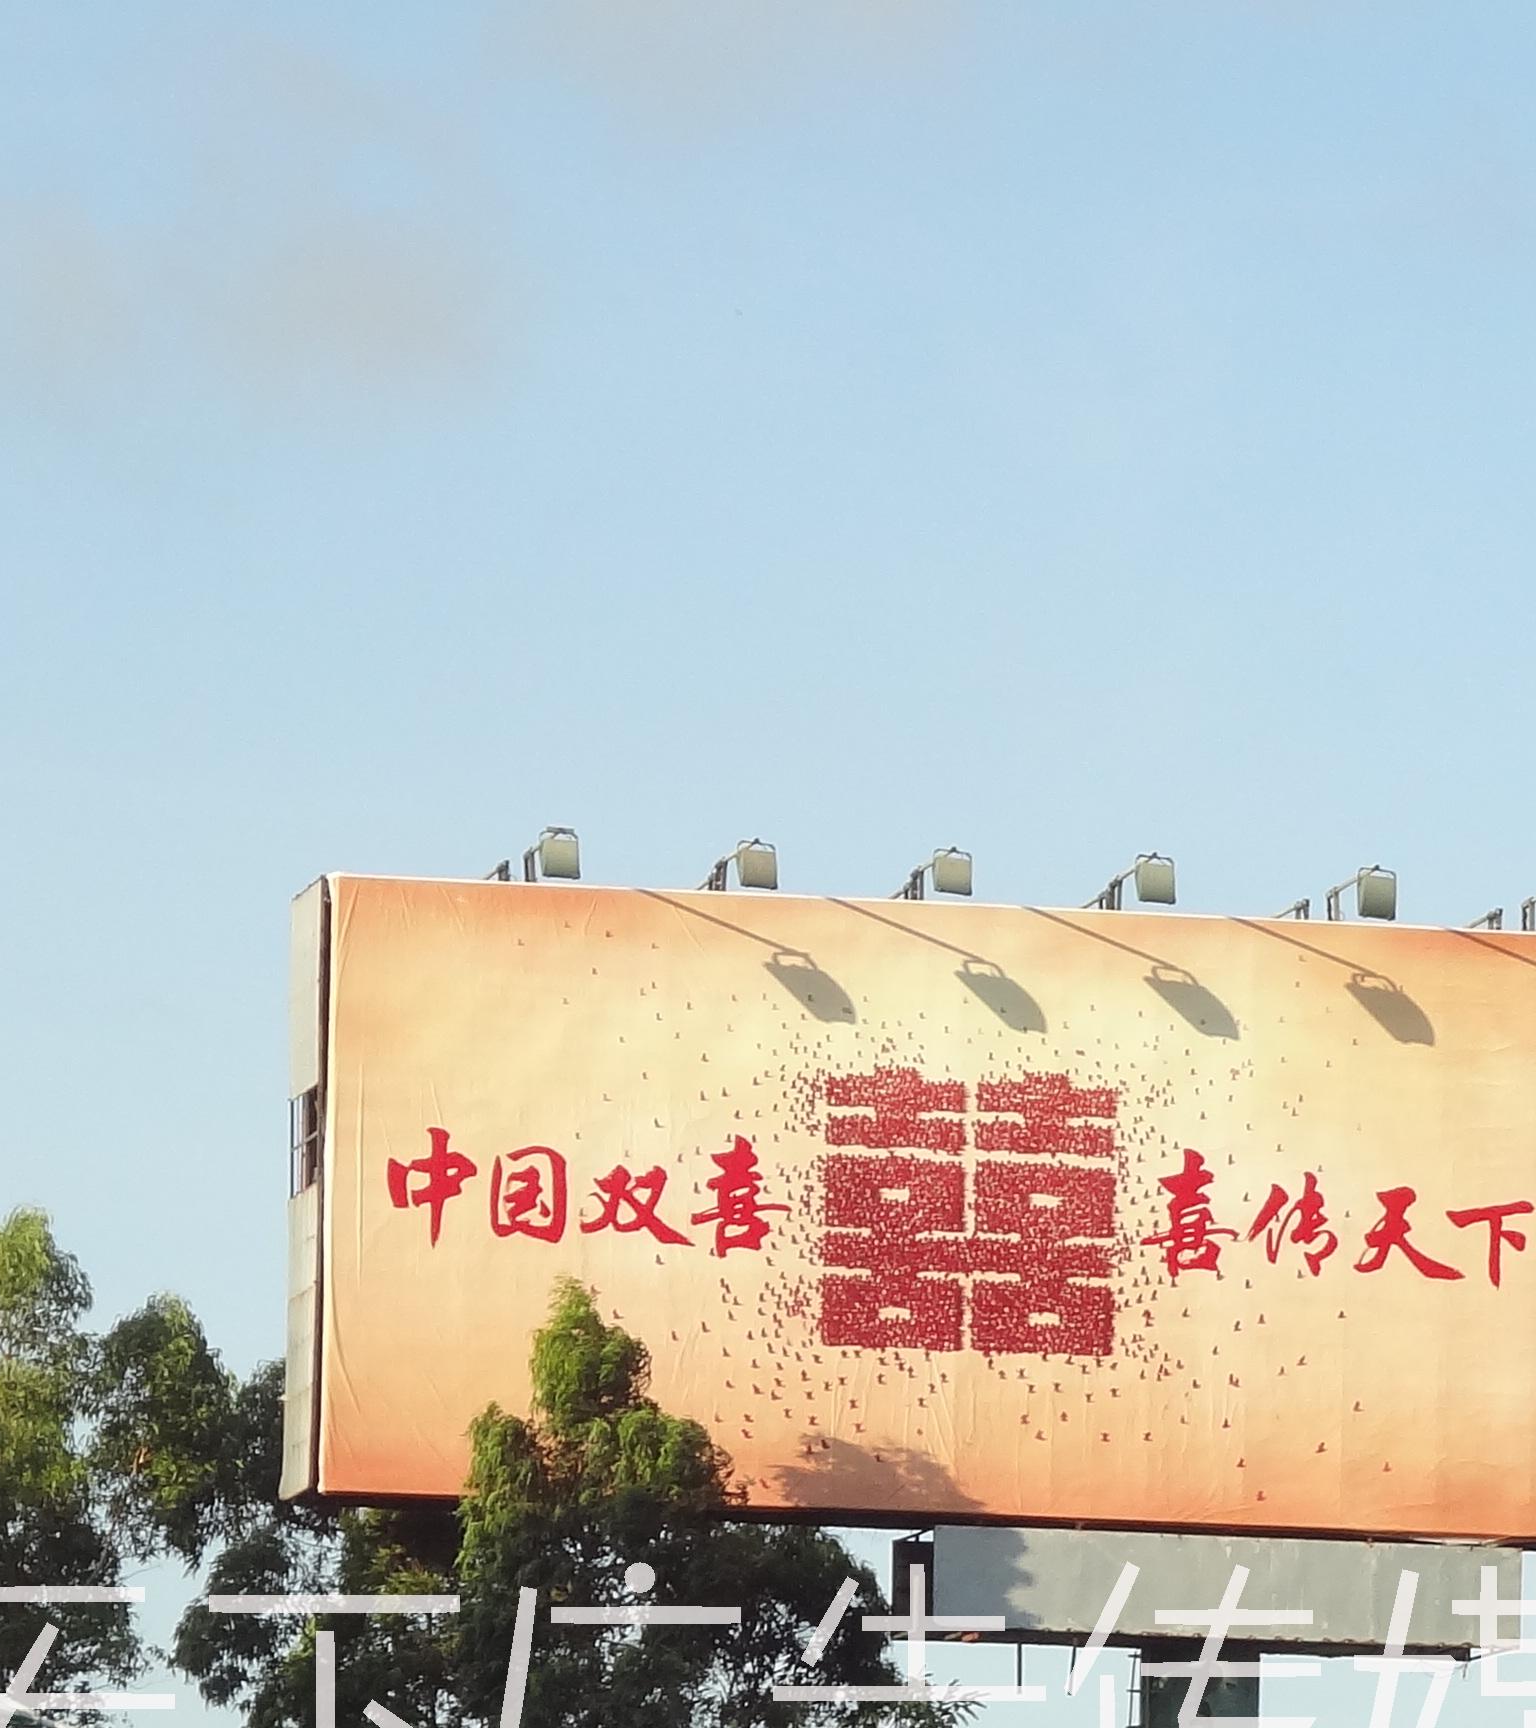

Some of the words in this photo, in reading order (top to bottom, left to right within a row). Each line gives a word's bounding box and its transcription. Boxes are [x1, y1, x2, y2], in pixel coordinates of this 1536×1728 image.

[387, 1127, 791, 1258] 中国双喜
[1140, 1148, 1535, 1290] 喜传天下
